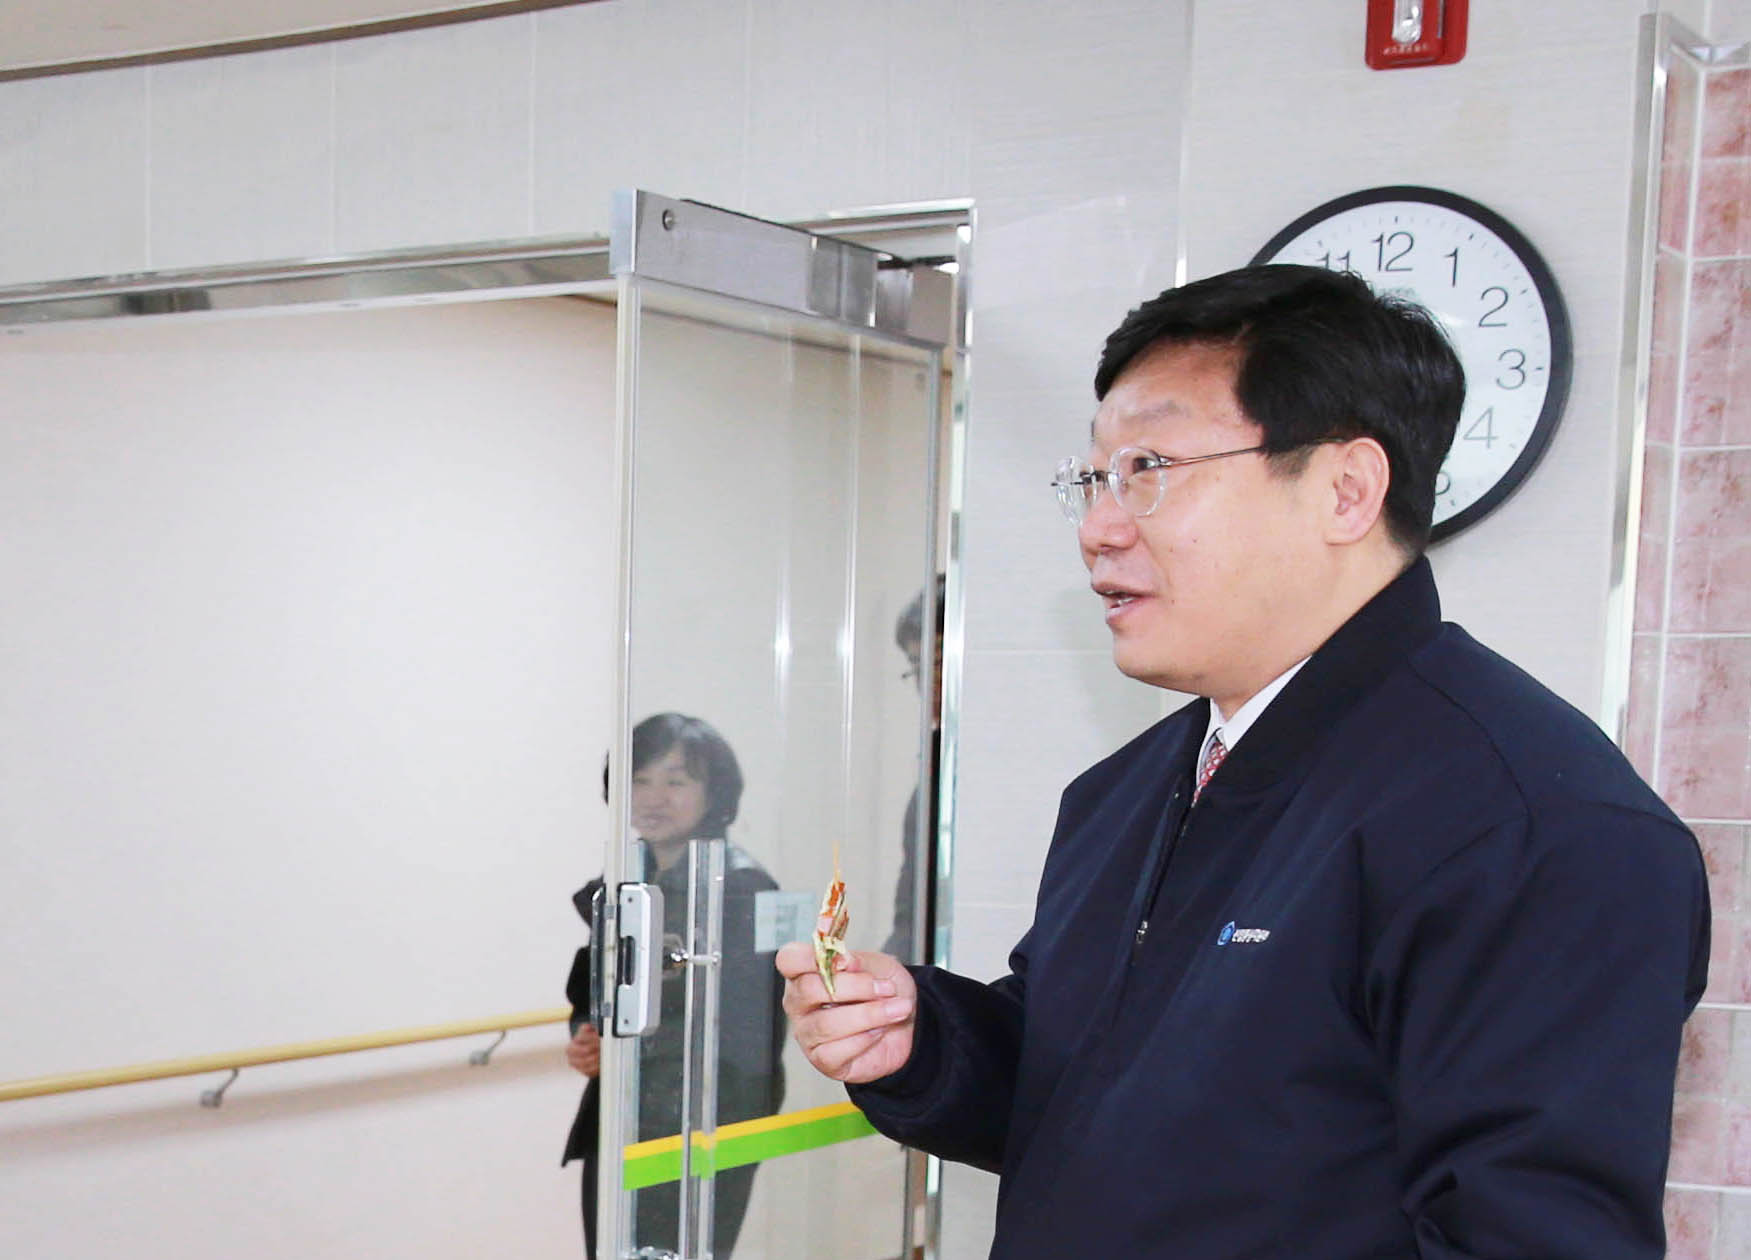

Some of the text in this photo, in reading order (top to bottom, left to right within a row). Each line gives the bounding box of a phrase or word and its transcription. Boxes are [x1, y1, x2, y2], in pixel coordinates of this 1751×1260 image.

[1372, 232, 1415, 273] 12
[1444, 247, 1459, 288] 1
[1478, 286, 1509, 328] 2
[1496, 349, 1526, 390] 3
[1463, 406, 1499, 449] 4
